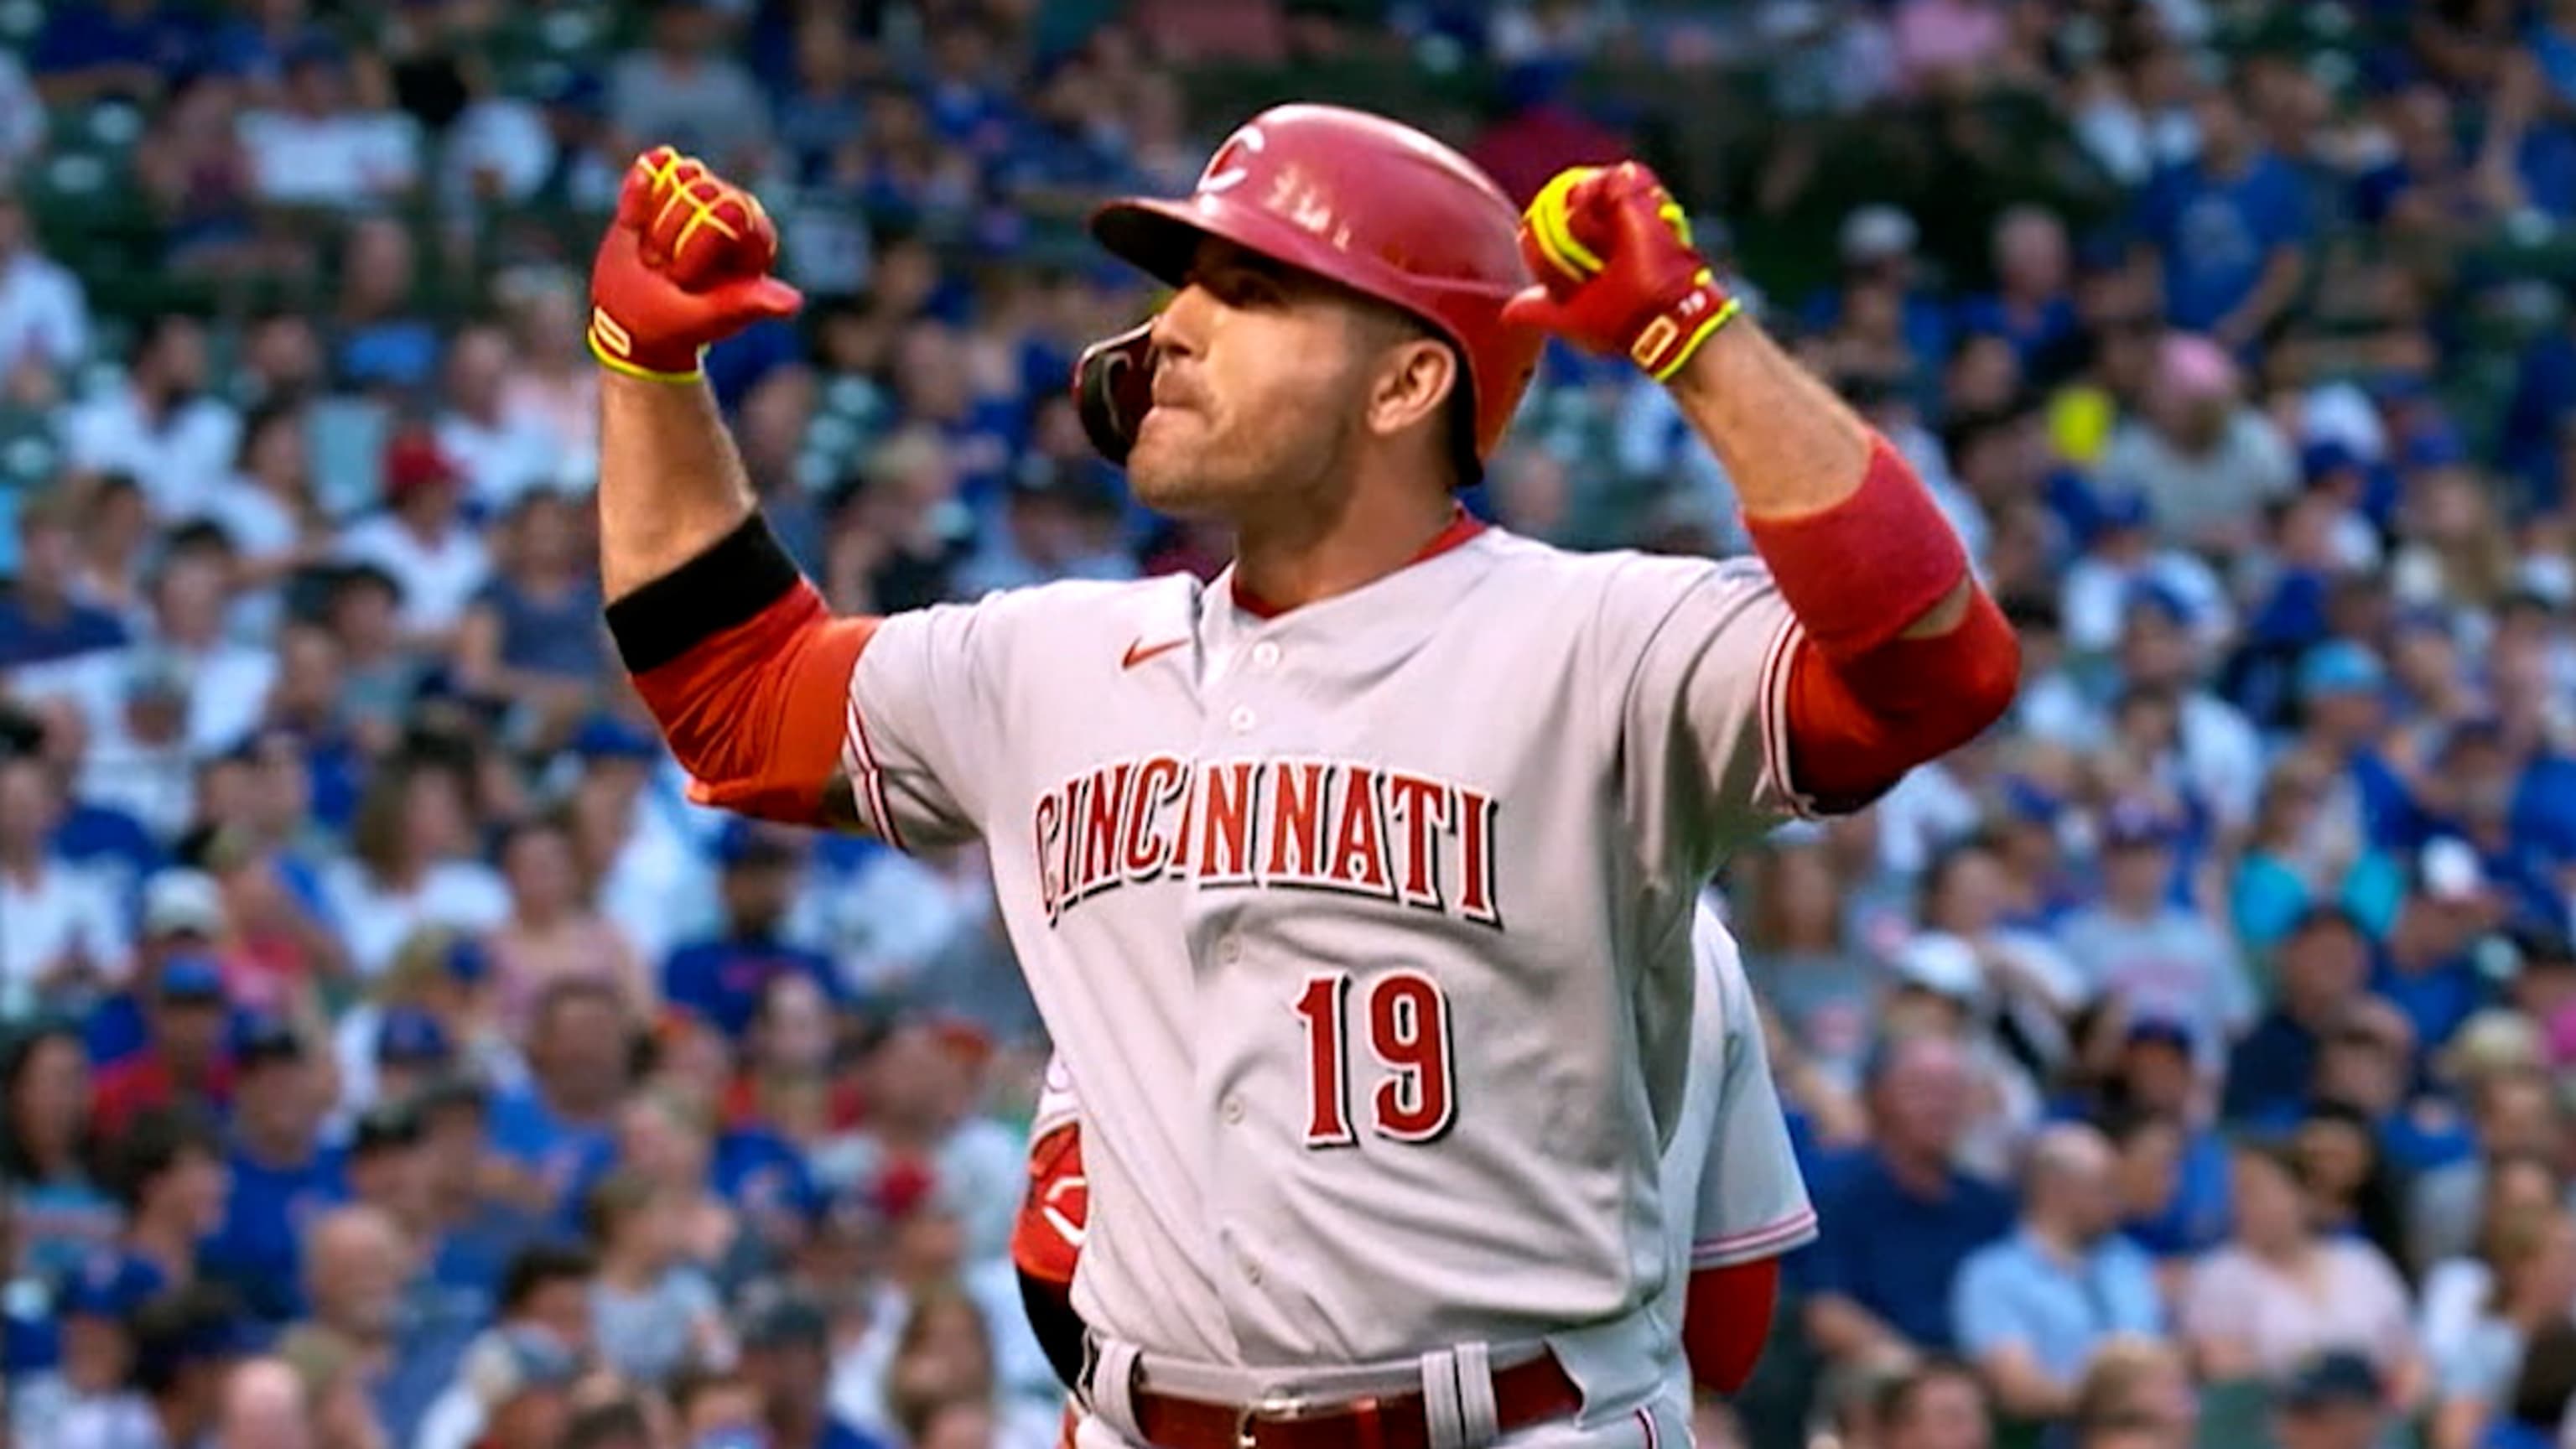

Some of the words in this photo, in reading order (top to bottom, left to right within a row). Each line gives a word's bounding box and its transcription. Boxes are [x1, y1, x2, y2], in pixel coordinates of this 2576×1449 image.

[1196, 125, 1265, 194] C
[1036, 756, 1504, 928] CINCINNATI
[1294, 969, 1457, 1150] 19
